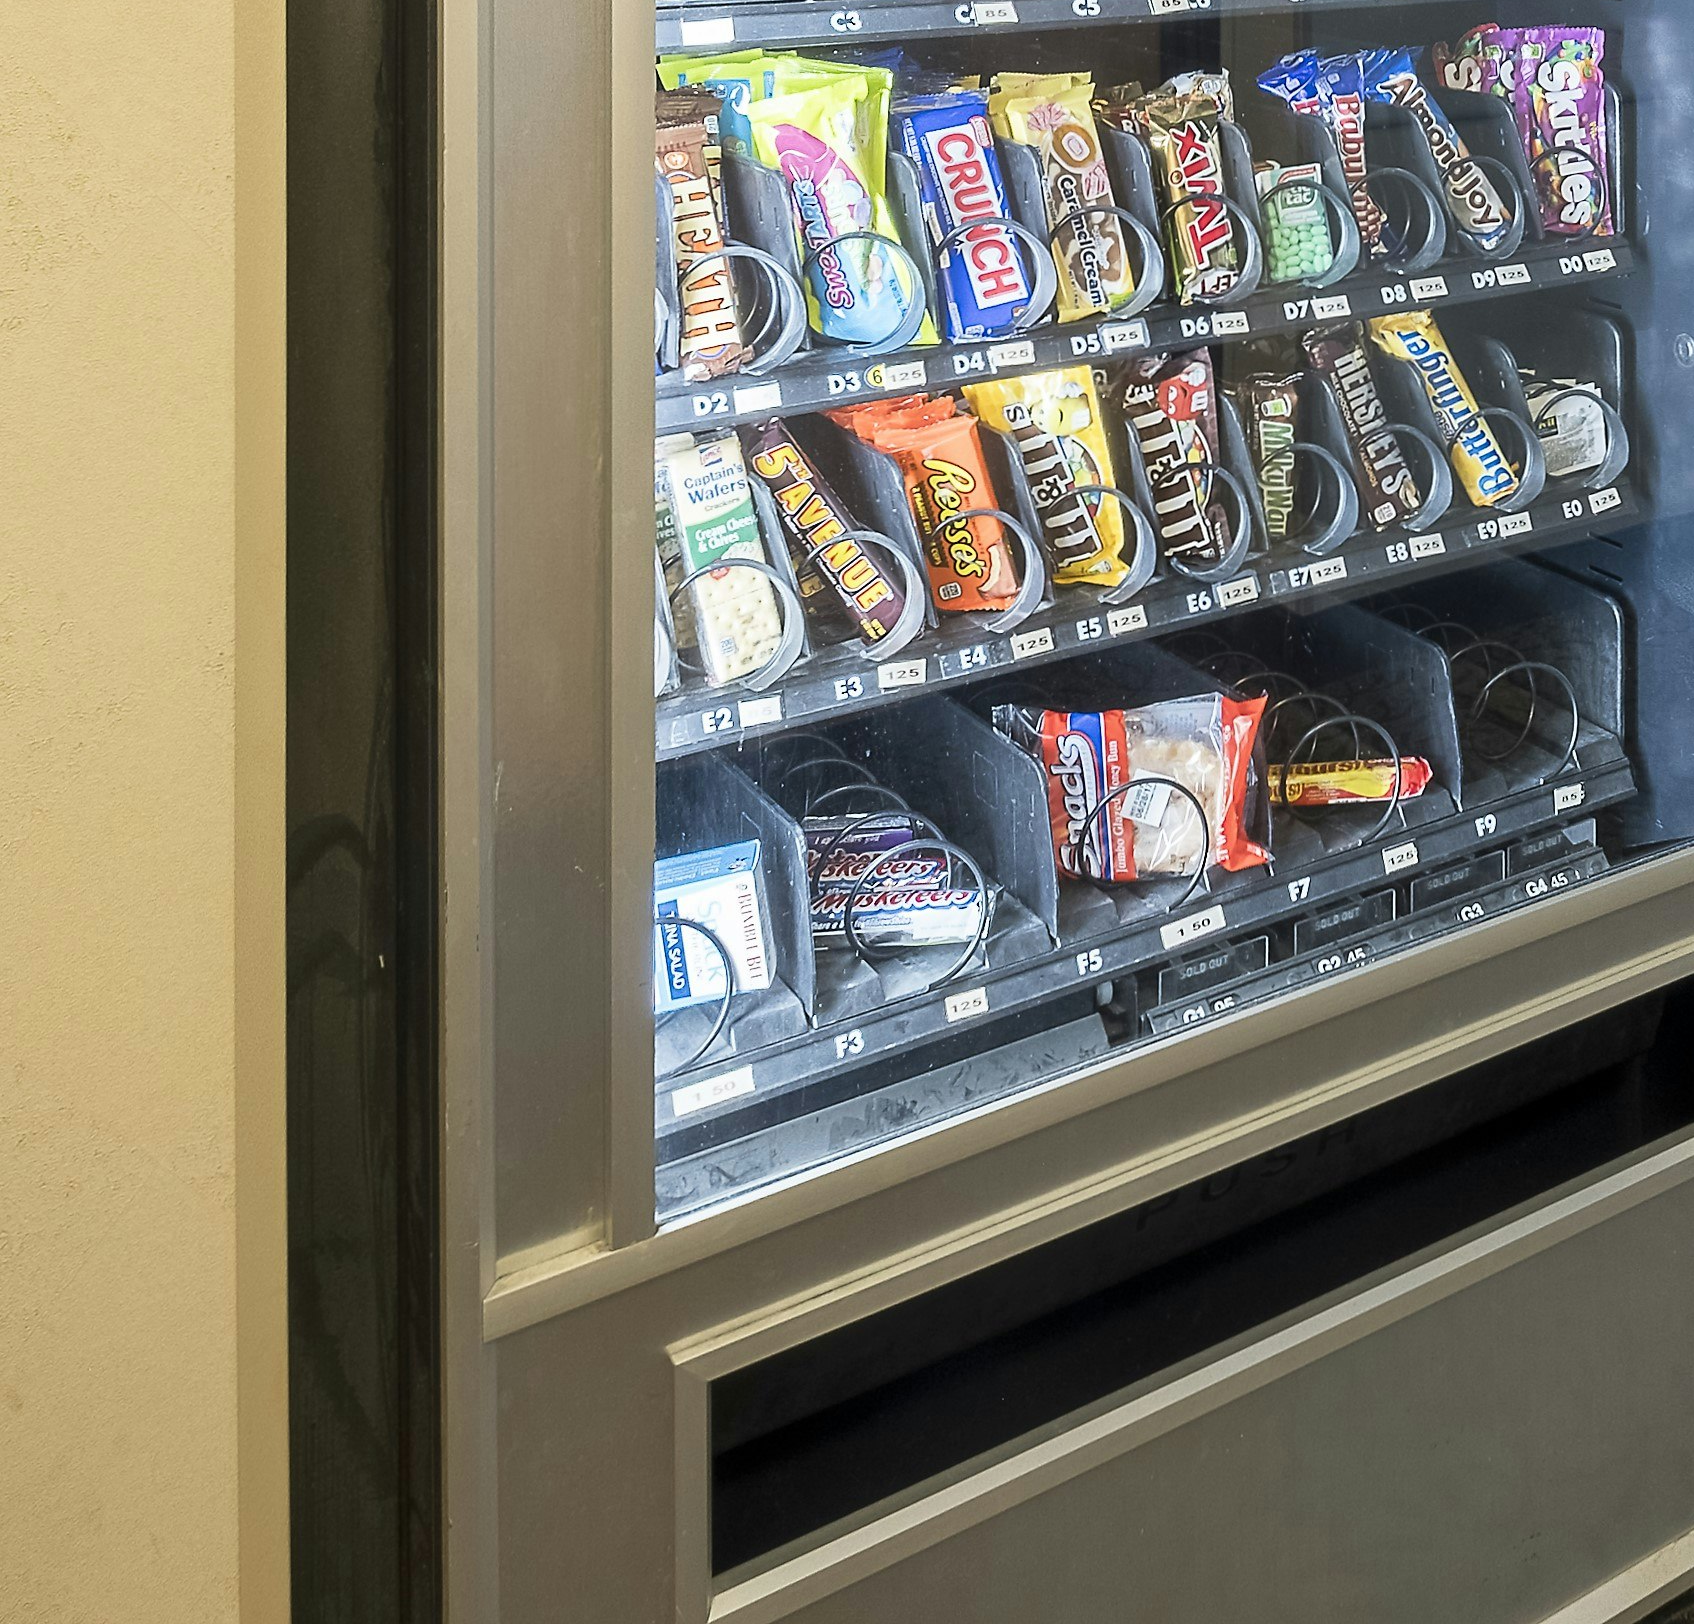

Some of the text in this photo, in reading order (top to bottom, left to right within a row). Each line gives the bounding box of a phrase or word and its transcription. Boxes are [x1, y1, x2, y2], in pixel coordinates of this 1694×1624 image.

[985, 8, 1008, 19] 85
[1536, 60, 1595, 227] Skittles
[1170, 121, 1232, 268] TWIX
[1285, 191, 1314, 207] tac
[937, 132, 1019, 300] CRUNCH
[1057, 174, 1093, 250] Caramel
[672, 176, 742, 352] HEATH
[1587, 255, 1611, 267] 125
[1471, 271, 1497, 290] D9
[1501, 268, 1525, 280] 125
[1381, 286, 1407, 305] D8
[1418, 280, 1444, 292] 125
[1283, 301, 1309, 320] D7
[1318, 302, 1345, 312] 125
[1180, 317, 1210, 336] D6
[1217, 318, 1245, 329] 125
[1070, 336, 1101, 356] D5
[1108, 331, 1139, 344] 125
[952, 353, 985, 375] D4
[828, 368, 862, 395] D3
[872, 369, 883, 384] 6
[692, 393, 729, 417] D2
[1396, 329, 1517, 496] Butterfinger
[683, 463, 744, 489] Captain's
[688, 478, 746, 505] Wafers
[1595, 496, 1616, 508] 125
[694, 524, 727, 542] Cream
[1477, 520, 1498, 540] E9
[1503, 519, 1527, 530] 125
[697, 532, 740, 554] & Chives
[775, 481, 895, 613] AVENUE
[1386, 542, 1409, 563] E8
[1415, 540, 1440, 551] 125
[1289, 568, 1309, 587] E7
[1315, 564, 1342, 577] 125
[1186, 591, 1212, 613] E6
[1223, 585, 1252, 599] 125
[1076, 618, 1103, 641] E5
[1111, 614, 1141, 627] 125
[1017, 637, 1049, 651] 125
[959, 646, 987, 669] E4
[887, 667, 919, 681] 125
[834, 676, 865, 701] E3
[701, 707, 734, 734] E2
[1107, 739, 1120, 765] Bun
[1051, 734, 1103, 878] Snacks
[1111, 797, 1125, 838] Glazed
[1475, 814, 1497, 837] F9
[1112, 839, 1129, 874] Jumbo
[1388, 849, 1414, 866] 125
[1451, 867, 1471, 883] OUT
[1551, 872, 1569, 888] 45
[1288, 877, 1311, 901] F7
[1525, 877, 1548, 897] G4
[1192, 917, 1212, 931] 50
[1339, 907, 1361, 924] OUT
[669, 947, 687, 991] SALAD
[1076, 949, 1103, 976] F5
[1208, 955, 1229, 971] OUT
[951, 998, 982, 1014] 125
[833, 1030, 865, 1060] F3
